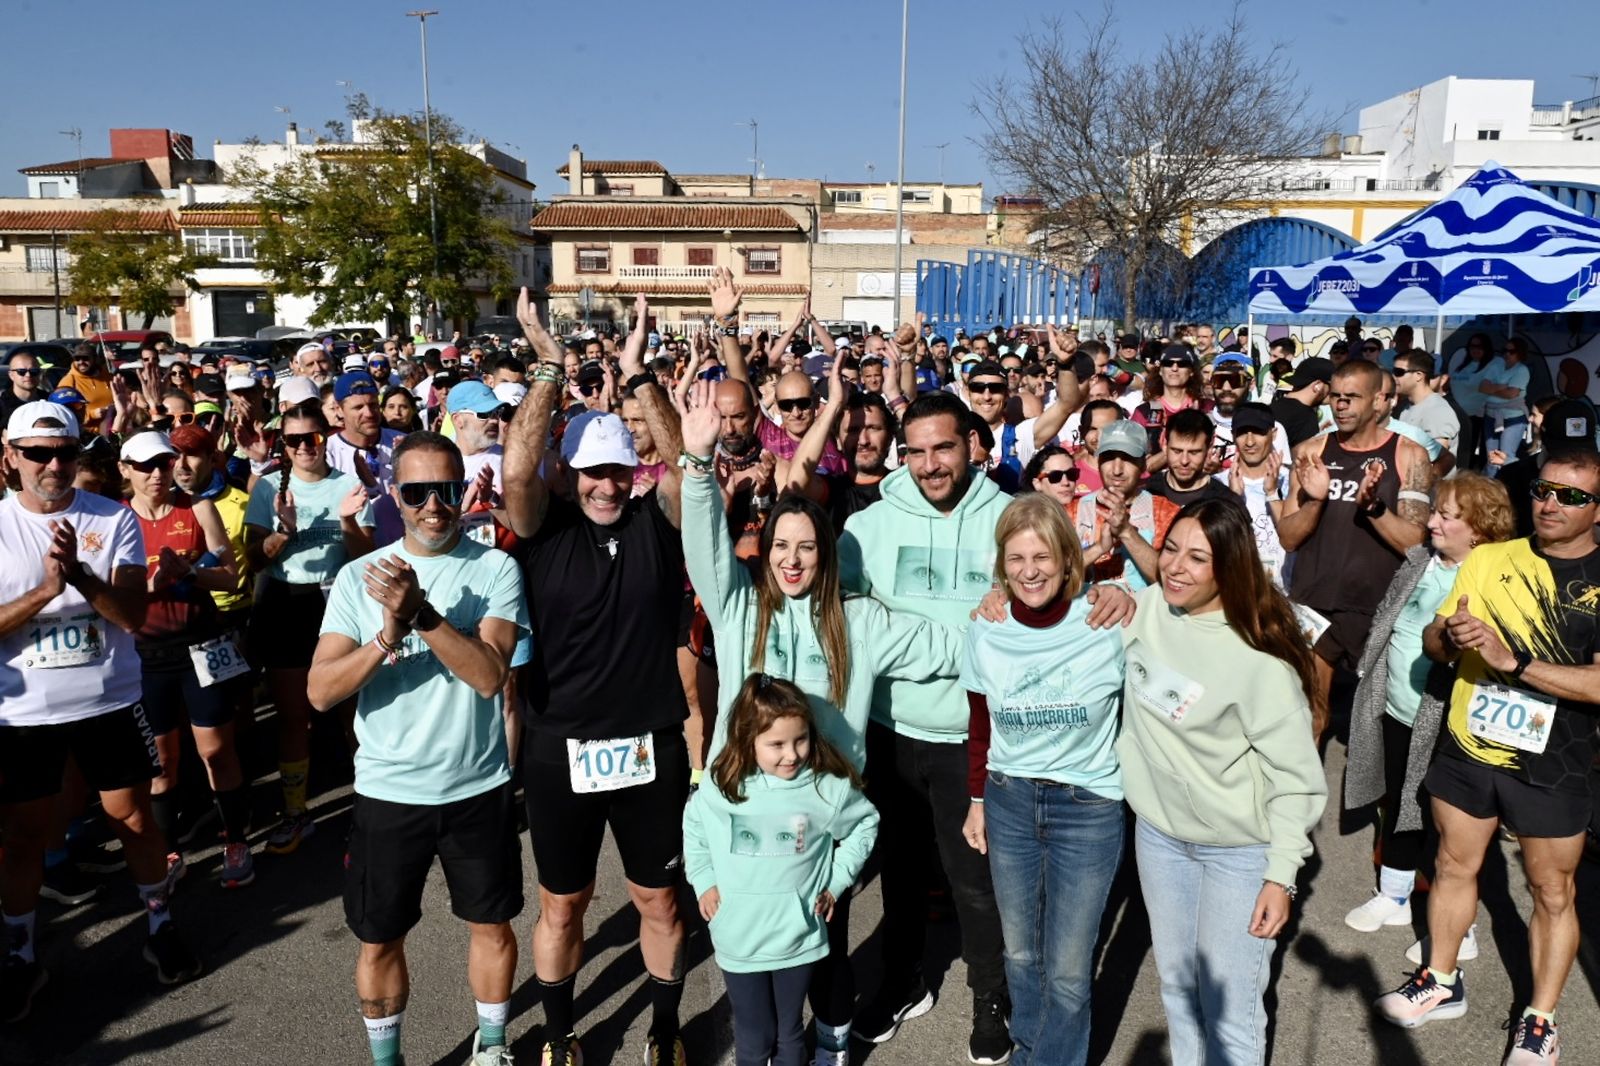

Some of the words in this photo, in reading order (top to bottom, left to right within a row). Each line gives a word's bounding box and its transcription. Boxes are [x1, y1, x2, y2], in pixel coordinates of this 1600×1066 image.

[1317, 279, 1361, 293] JEREZ2031
[1328, 478, 1359, 502] 92
[29, 625, 82, 653] 110
[205, 647, 232, 671] 88
[1026, 706, 1088, 726] GUERRERA
[1471, 694, 1527, 730] 270
[579, 745, 631, 778] 107
